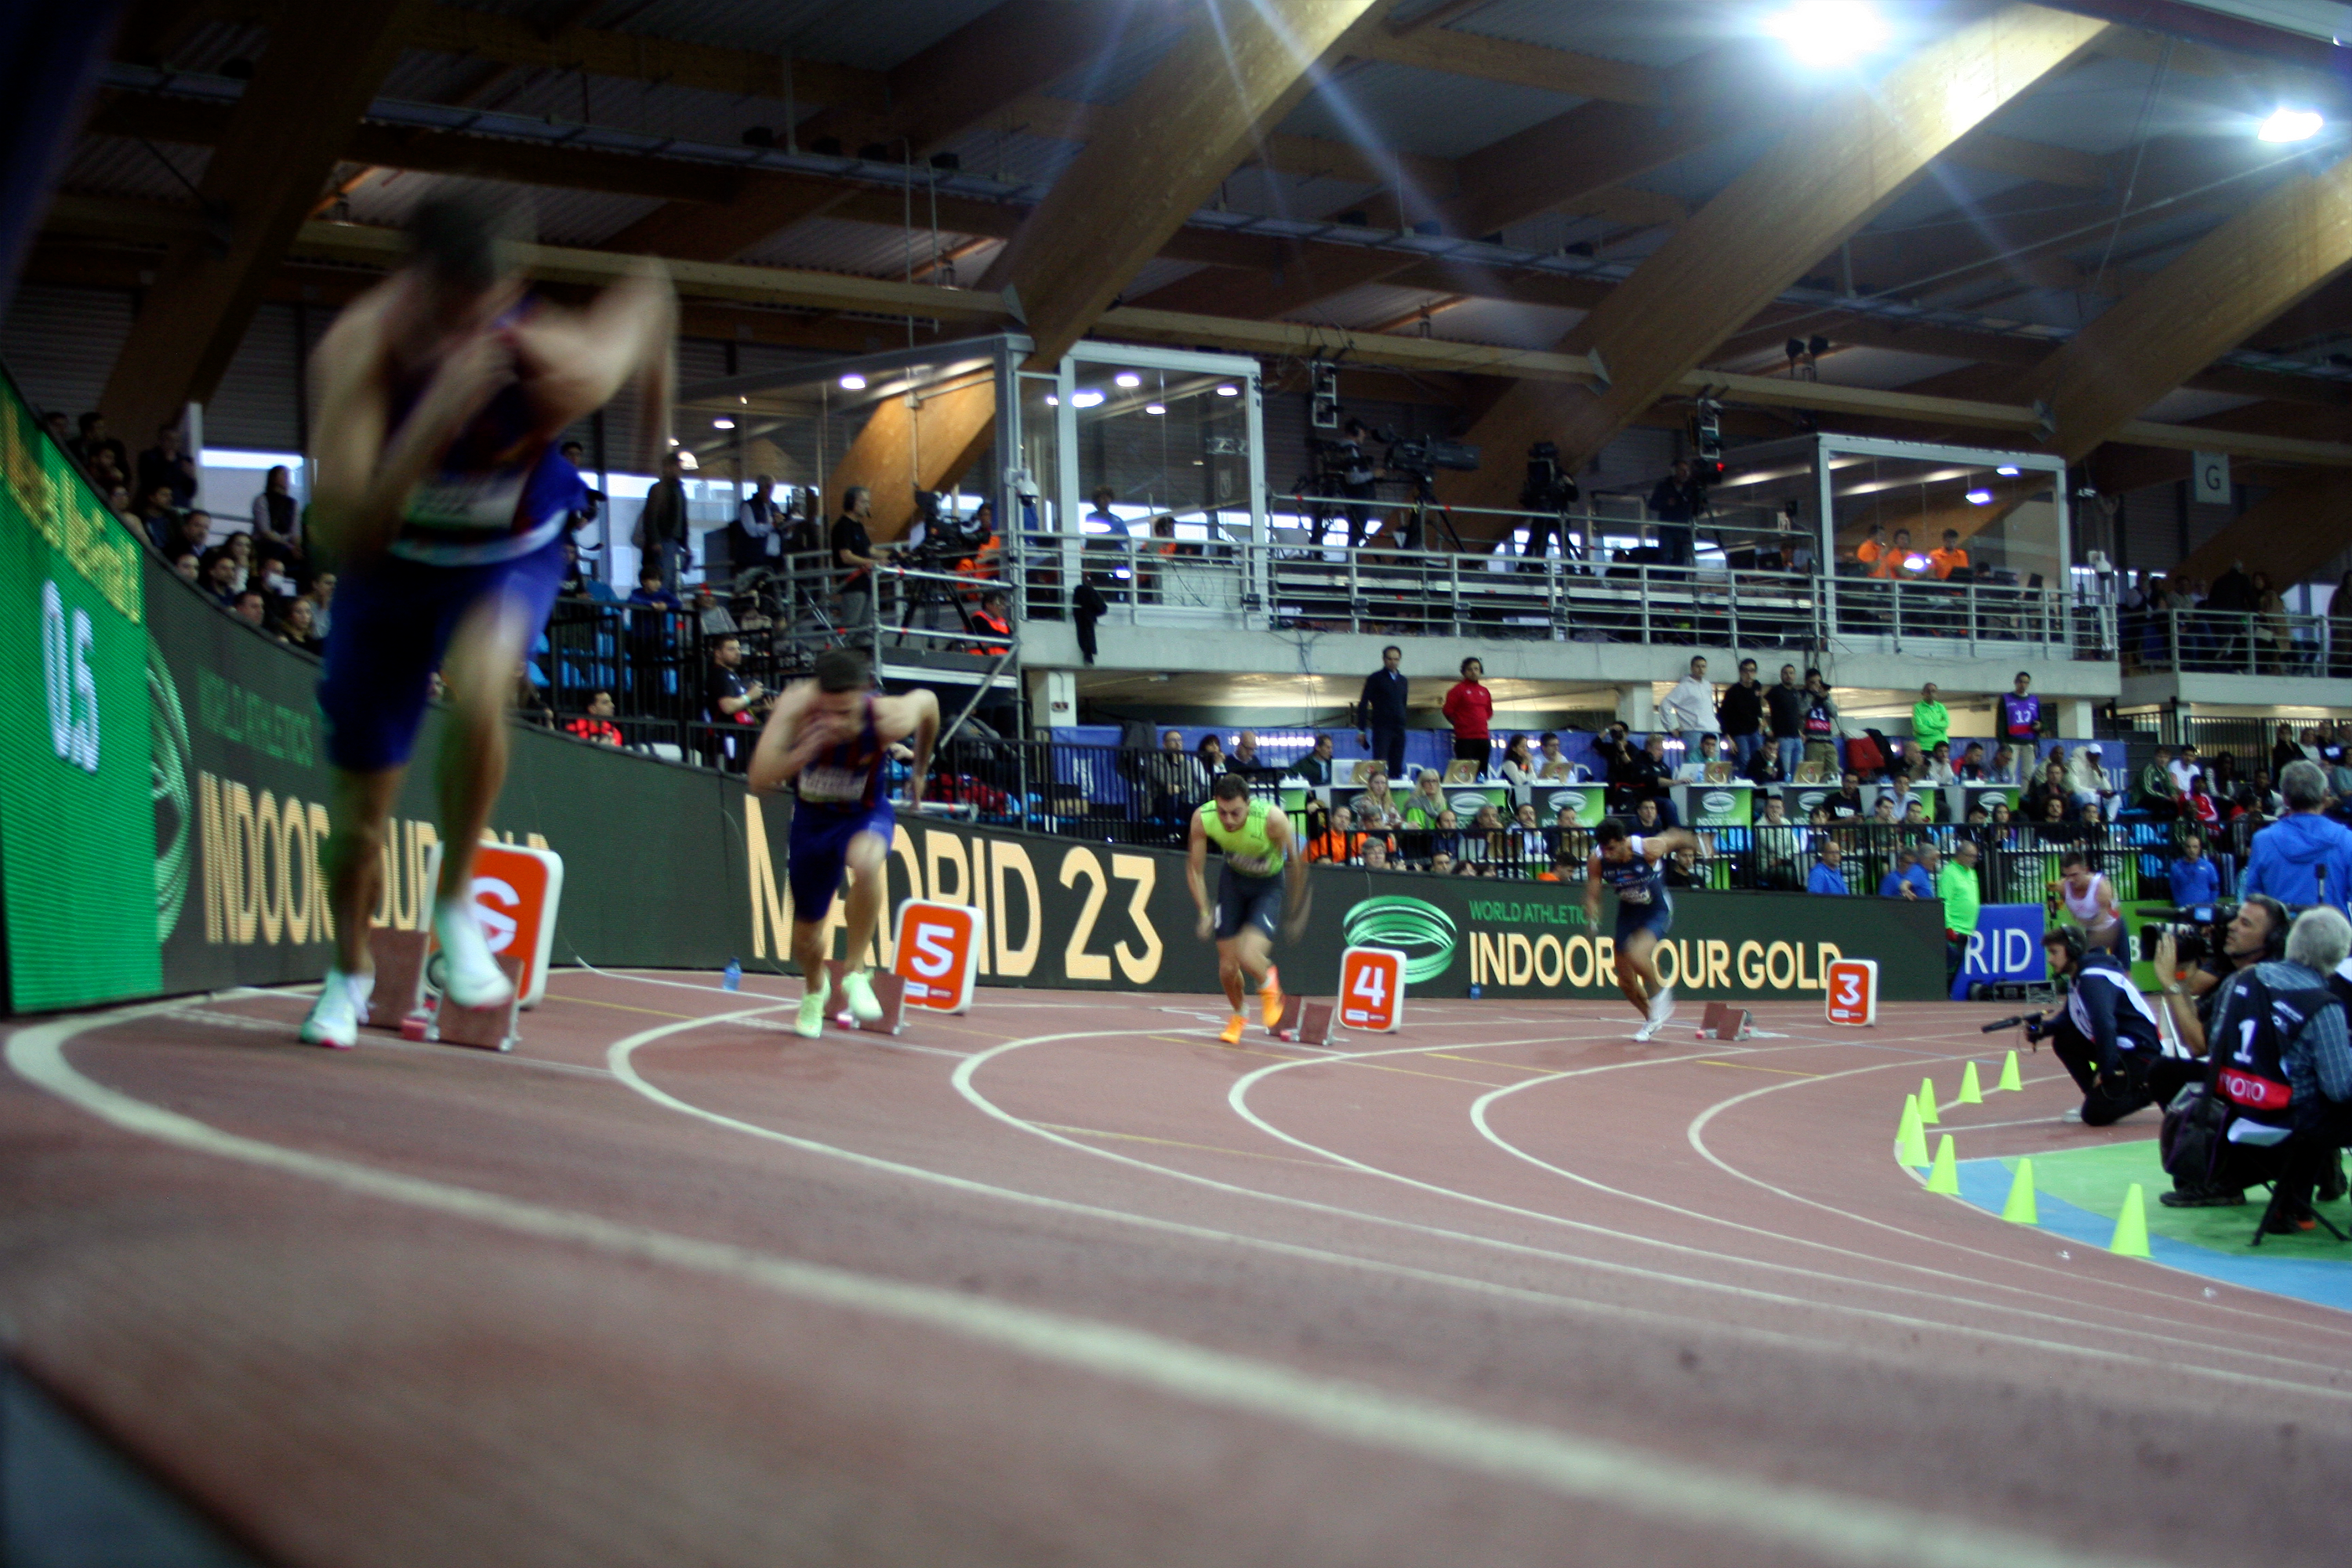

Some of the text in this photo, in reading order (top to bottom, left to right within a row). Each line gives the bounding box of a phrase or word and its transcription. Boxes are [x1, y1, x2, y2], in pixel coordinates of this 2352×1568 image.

[2205, 464, 2221, 490] G
[1059, 846, 1163, 985] 23
[1469, 900, 1521, 923] WORLD
[911, 922, 954, 977] 5
[1469, 931, 1620, 988] INDOOR
[1651, 938, 1731, 989] OUR
[1352, 965, 1385, 1007] 4
[1836, 973, 1860, 1006] 3
[2233, 1019, 2256, 1063] 1
